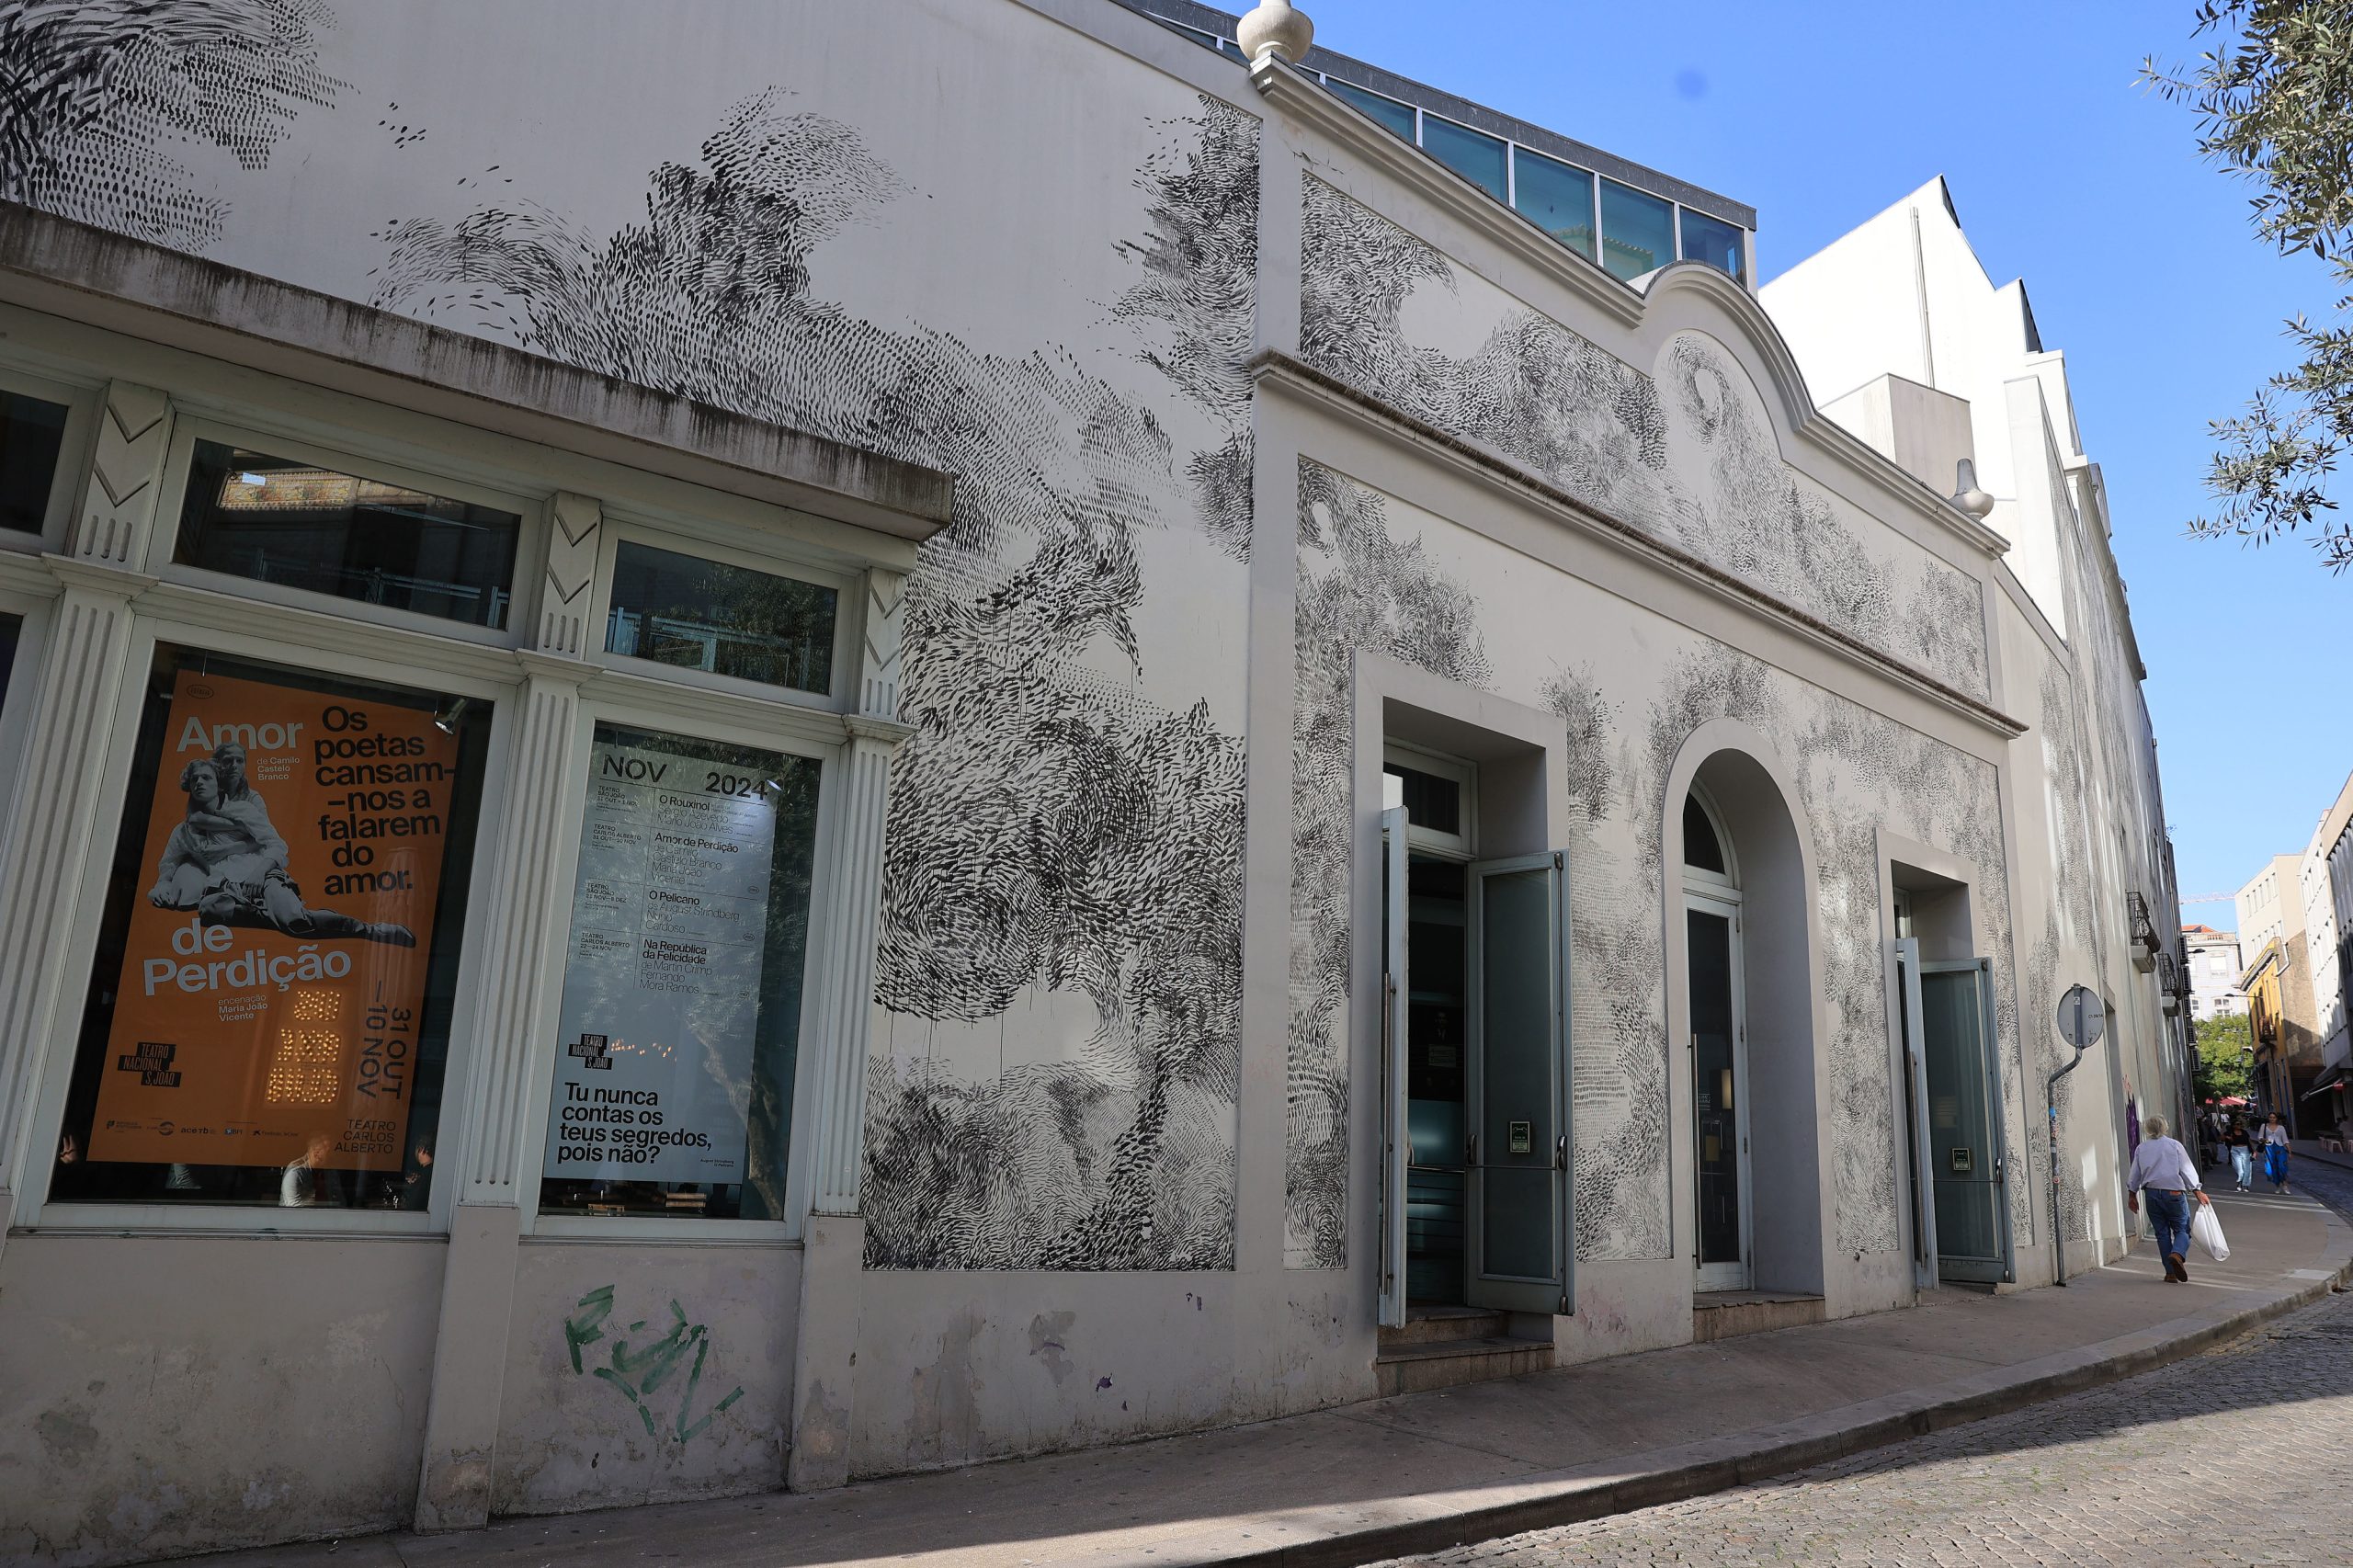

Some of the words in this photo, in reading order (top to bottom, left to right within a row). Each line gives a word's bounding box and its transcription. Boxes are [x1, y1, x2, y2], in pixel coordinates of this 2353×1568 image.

[322, 705, 368, 733] Os
[176, 716, 303, 752] Amor
[314, 733, 426, 765] poetas
[256, 757, 268, 766] de
[269, 756, 301, 766] Camilo
[257, 765, 291, 774] Castelo
[257, 773, 290, 781] Branco
[314, 761, 456, 787] cansam-
[602, 754, 667, 783] NOV
[705, 772, 767, 801] 2024
[598, 785, 620, 793] TEATRO
[412, 788, 431, 809] a
[659, 795, 668, 804] O
[669, 796, 710, 811] Rouxinol
[317, 813, 440, 840] falarem
[594, 824, 616, 832] TEATRO
[654, 832, 682, 846] Amor
[683, 836, 696, 847] de
[698, 838, 739, 854] Perdição
[665, 845, 699, 857] Camilo
[331, 840, 374, 867] do
[653, 853, 688, 866] Castelo
[689, 858, 722, 869] Branco
[652, 861, 676, 873] Maria
[324, 869, 413, 896] amor.
[651, 871, 686, 885] Vicente
[649, 890, 657, 900] O
[659, 892, 699, 905] Pelicano
[659, 902, 692, 915] August
[693, 905, 740, 923] Strindberg
[645, 919, 686, 934] Cardoso
[171, 917, 233, 956] de
[643, 938, 658, 950] Na
[659, 940, 707, 955] República
[642, 949, 655, 960] da
[656, 950, 706, 965] Felicidade
[143, 944, 352, 996] Perdição
[641, 960, 653, 970] de
[654, 961, 683, 972] Martin
[684, 963, 713, 976] Crimp
[641, 970, 686, 983] Fernando
[639, 979, 665, 992] Mora
[665, 982, 699, 994] Ramos
[218, 994, 267, 1006] encenação
[219, 1004, 245, 1015] Maria
[246, 1001, 268, 1012] João
[219, 1011, 255, 1022] Vicente
[389, 1006, 412, 1033] 31
[584, 1035, 604, 1047] TEATRO
[142, 1043, 169, 1059] TEATRO
[572, 1044, 599, 1057] NACIONAL
[123, 1056, 163, 1072] NACIONAL
[357, 1037, 384, 1100] NOV
[381, 1040, 407, 1100] OUT
[564, 1082, 588, 1102] Tu
[594, 1088, 658, 1107] nunca
[562, 1105, 634, 1124] contas
[638, 1109, 664, 1126] os
[347, 1119, 396, 1131] TEATRO
[343, 1130, 395, 1142] CARLOS
[560, 1122, 607, 1142] teus
[610, 1128, 712, 1152] segredos,
[334, 1142, 393, 1154] ALBERTO
[557, 1142, 603, 1165] pois
[608, 1144, 661, 1165] não?
